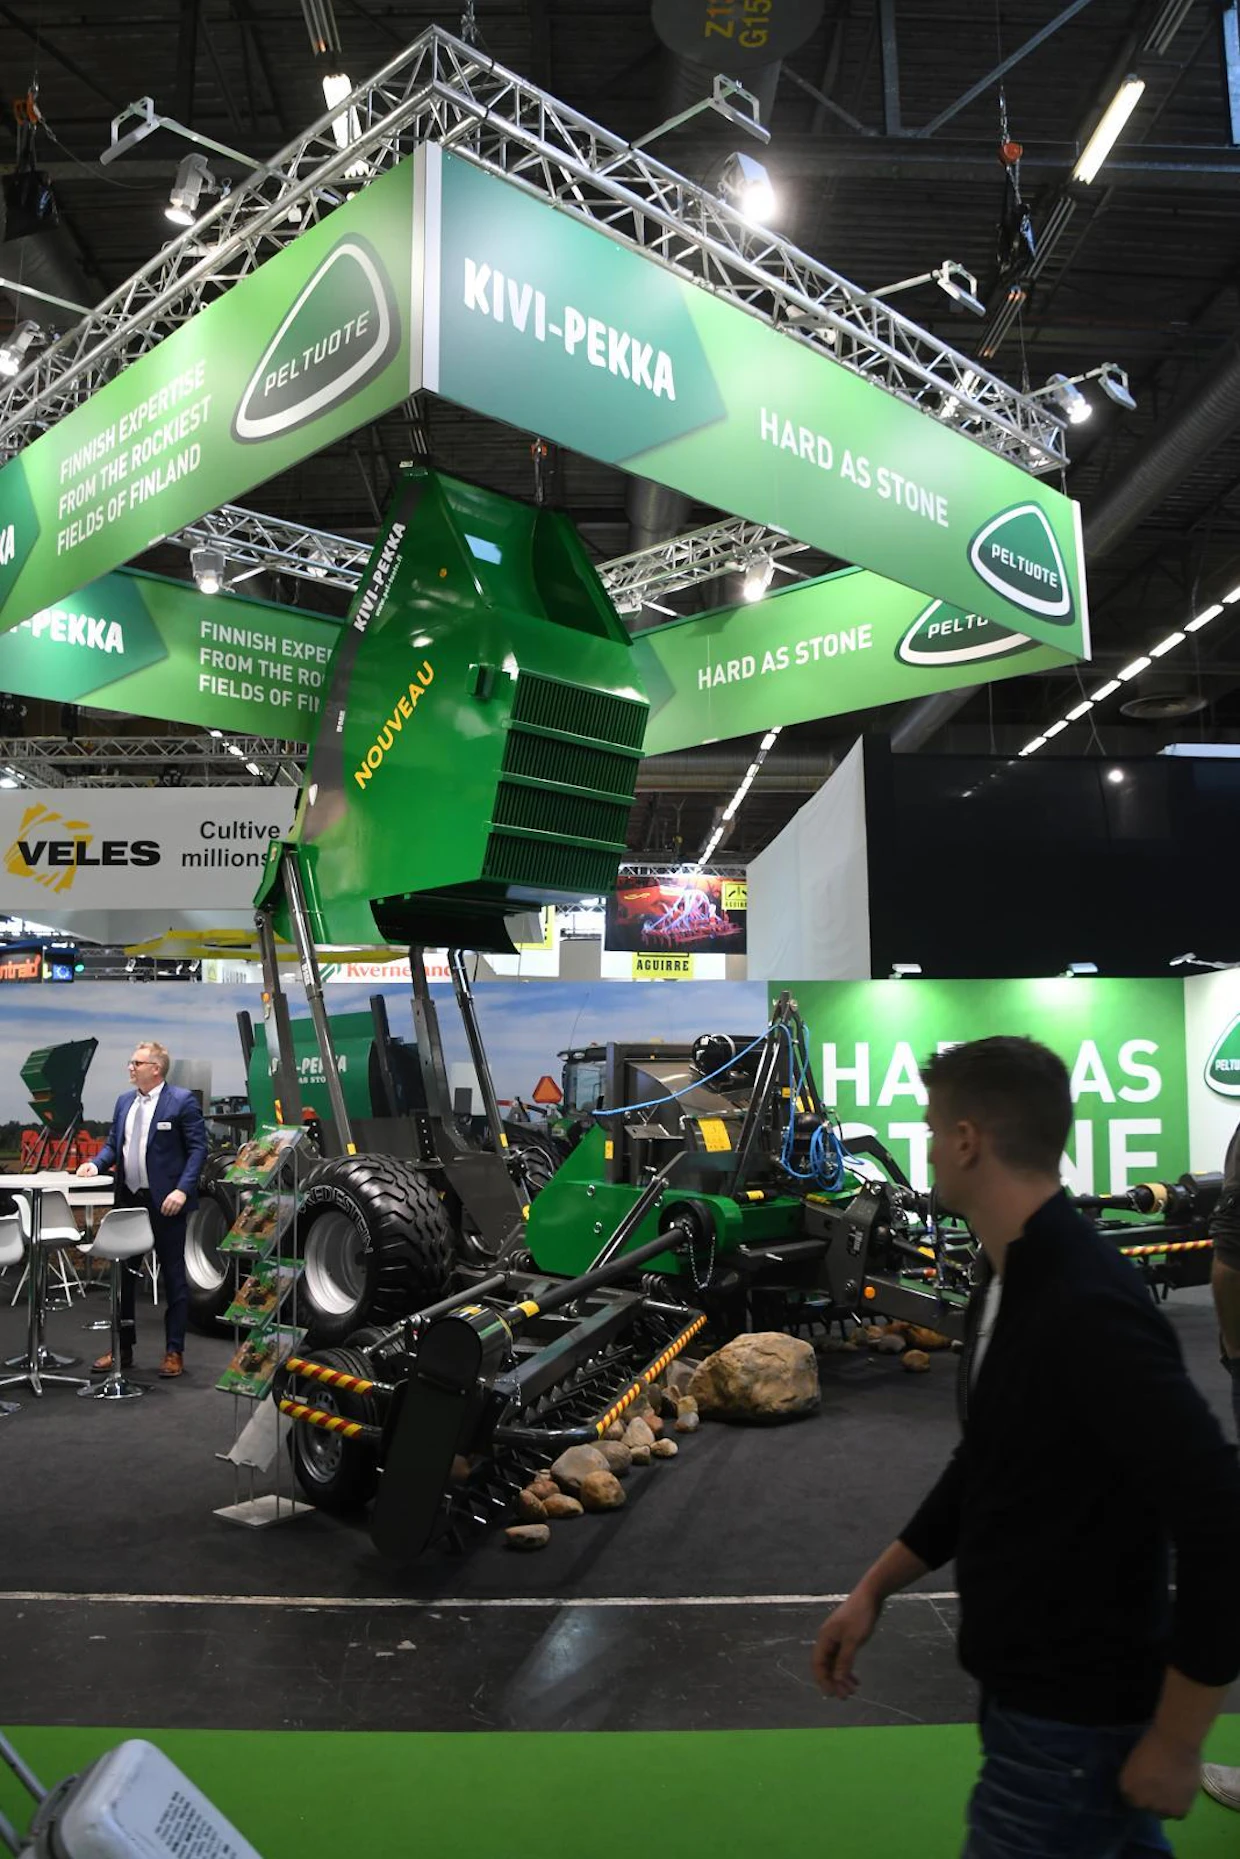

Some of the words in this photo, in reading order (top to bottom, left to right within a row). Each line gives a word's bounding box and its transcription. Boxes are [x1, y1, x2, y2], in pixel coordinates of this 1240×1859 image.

[263, 310, 370, 397] PELTUOTE
[463, 256, 677, 402] KIVI-PEKKA
[59, 423, 116, 485] FINNISH
[118, 358, 206, 444] EXPERTISE
[58, 474, 97, 521] FROM
[100, 452, 129, 491] THE
[130, 393, 212, 471] ROCKIEST
[760, 405, 834, 470] HARD
[839, 448, 872, 490] AS
[876, 465, 949, 528] STONE
[57, 504, 105, 556] FIELDS
[107, 489, 127, 524] OF
[129, 442, 202, 510] FINLAND
[353, 522, 407, 632] KIVI-PEKKA
[991, 542, 1058, 588] PELTUOTE
[200, 620, 277, 653] FINNISH
[200, 647, 253, 675] FROM
[257, 659, 293, 683] THE
[697, 655, 756, 690] HARD
[760, 645, 790, 675] AS
[795, 623, 873, 665] STONE
[198, 673, 265, 703] FIELDS
[269, 687, 293, 707] OF
[354, 660, 434, 790] NOUVEAU
[17, 840, 161, 866] VELES
[200, 820, 281, 840] Cultive
[636, 959, 689, 972] AGUIRRE
[1070, 1038, 1163, 1104] AS
